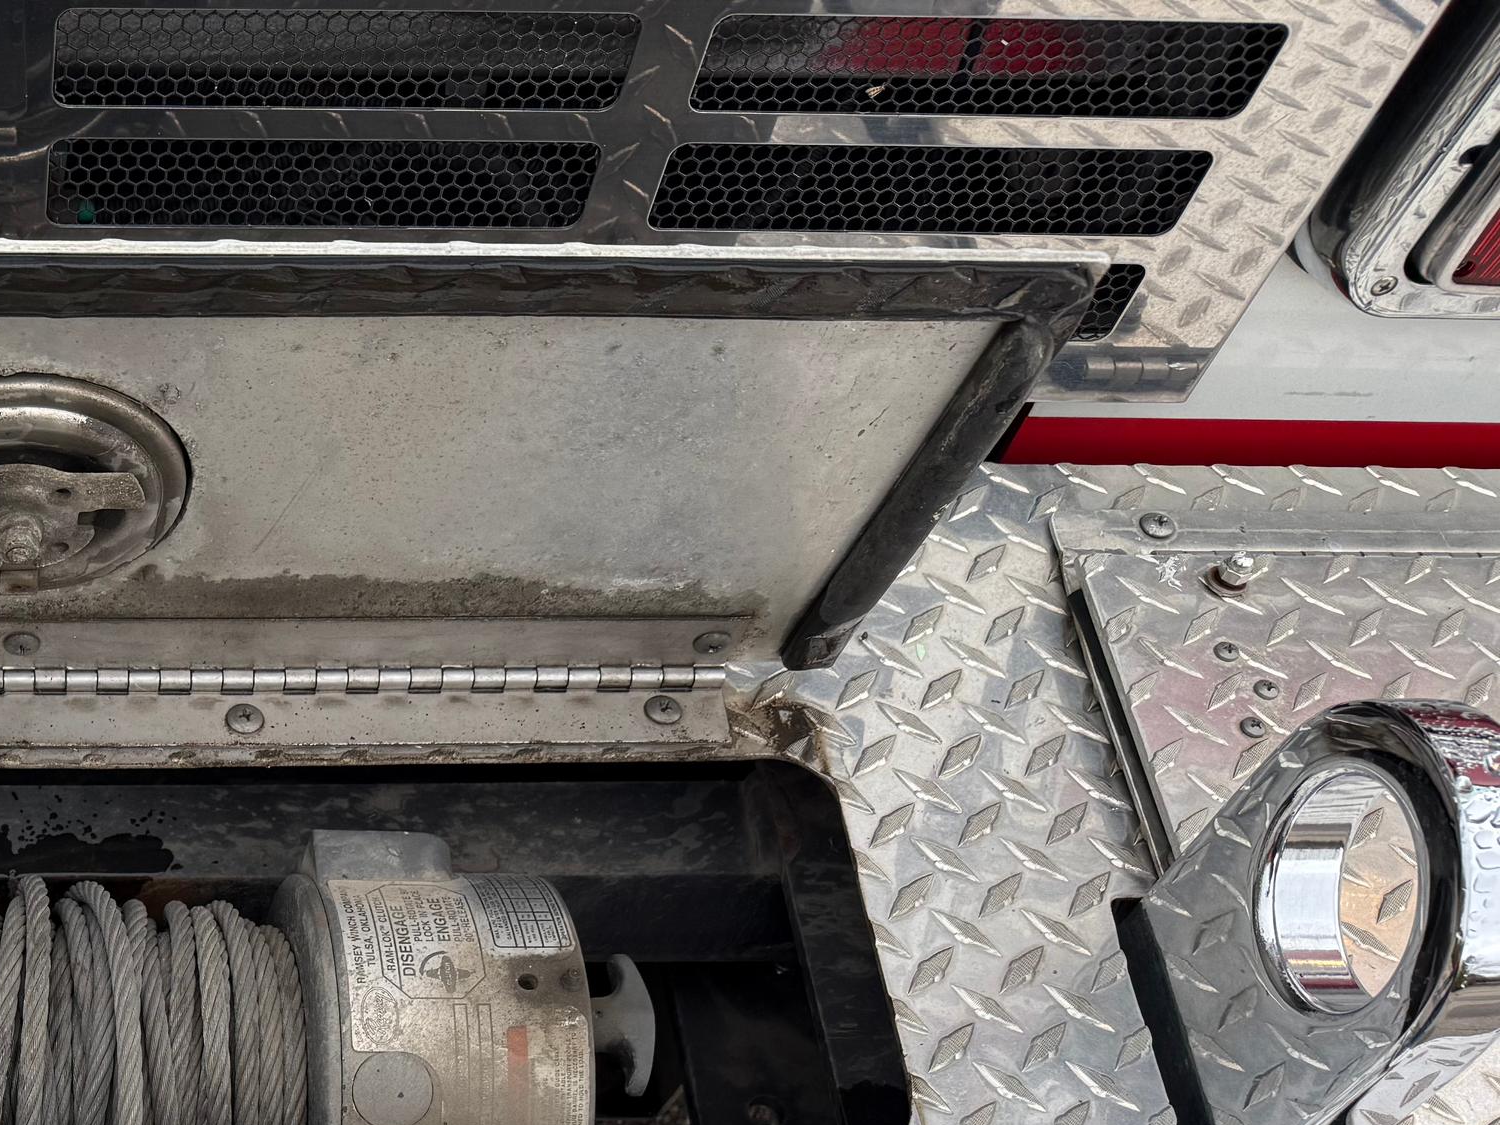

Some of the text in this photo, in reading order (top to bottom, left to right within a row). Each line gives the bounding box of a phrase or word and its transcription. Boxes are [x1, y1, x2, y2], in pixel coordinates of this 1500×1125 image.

[371, 896, 388, 924] CLUTCH
[402, 896, 424, 942] PULL-ROTATE
[410, 889, 426, 909] PLACE
[426, 897, 451, 942] ENGAGE
[442, 895, 464, 943] PULL-ROTATE
[345, 915, 361, 942] WINCH
[352, 894, 377, 967] TULSA, OKLAHOMA
[389, 904, 417, 977] DISENGAGE
[421, 921, 435, 942] LOCK
[351, 944, 369, 984] RAMSEY
